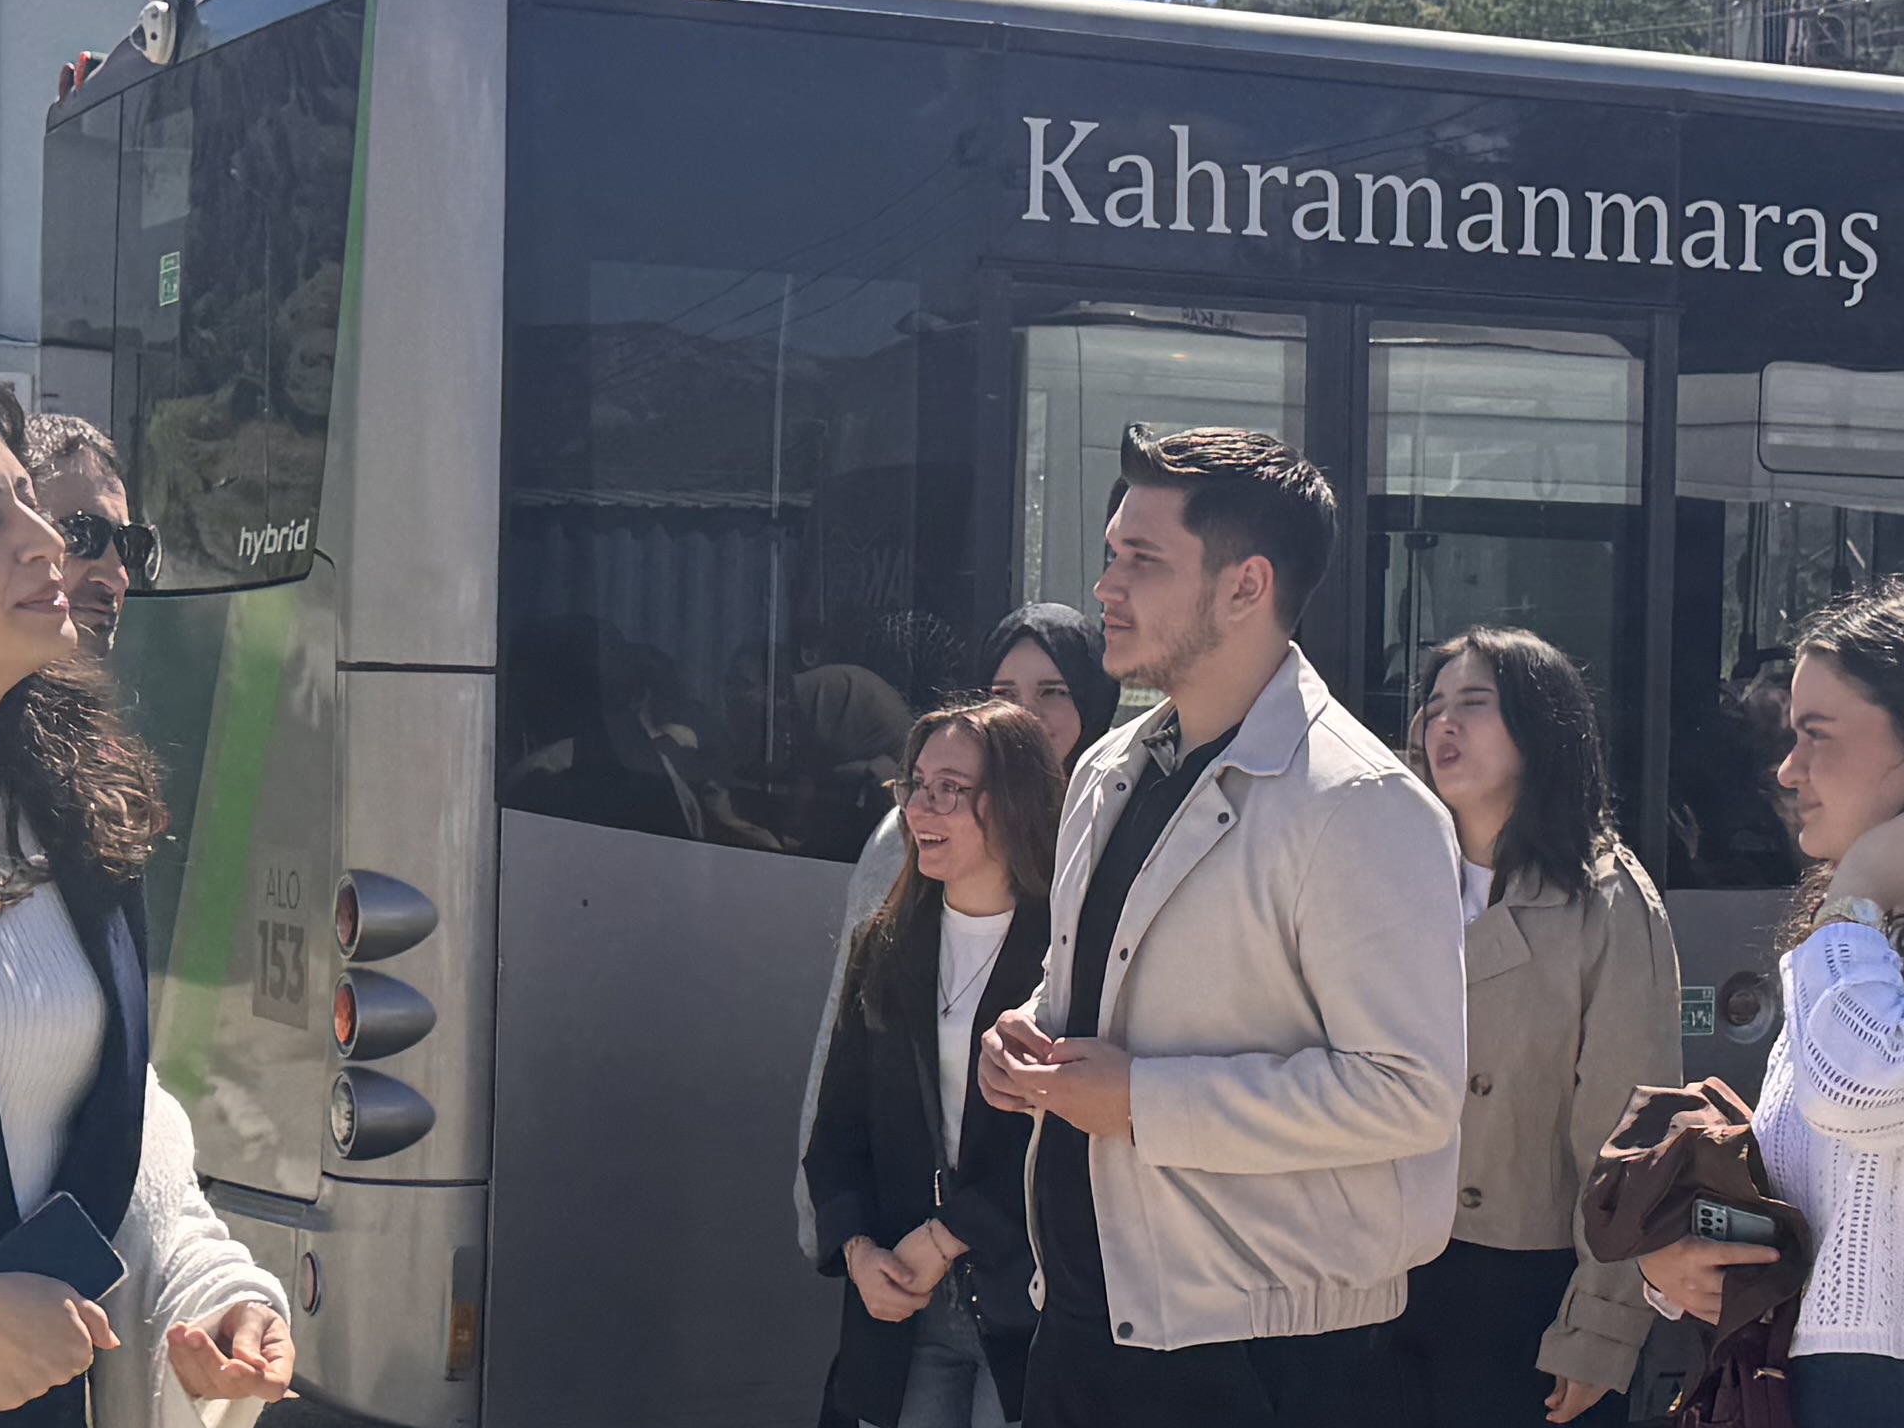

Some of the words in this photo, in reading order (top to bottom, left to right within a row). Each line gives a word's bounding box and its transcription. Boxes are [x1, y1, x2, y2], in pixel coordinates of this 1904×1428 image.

[1020, 114, 1881, 308] Kahramanmaraş
[238, 518, 310, 566] hybrid
[265, 867, 300, 910] ALO
[258, 919, 304, 1004] 153
